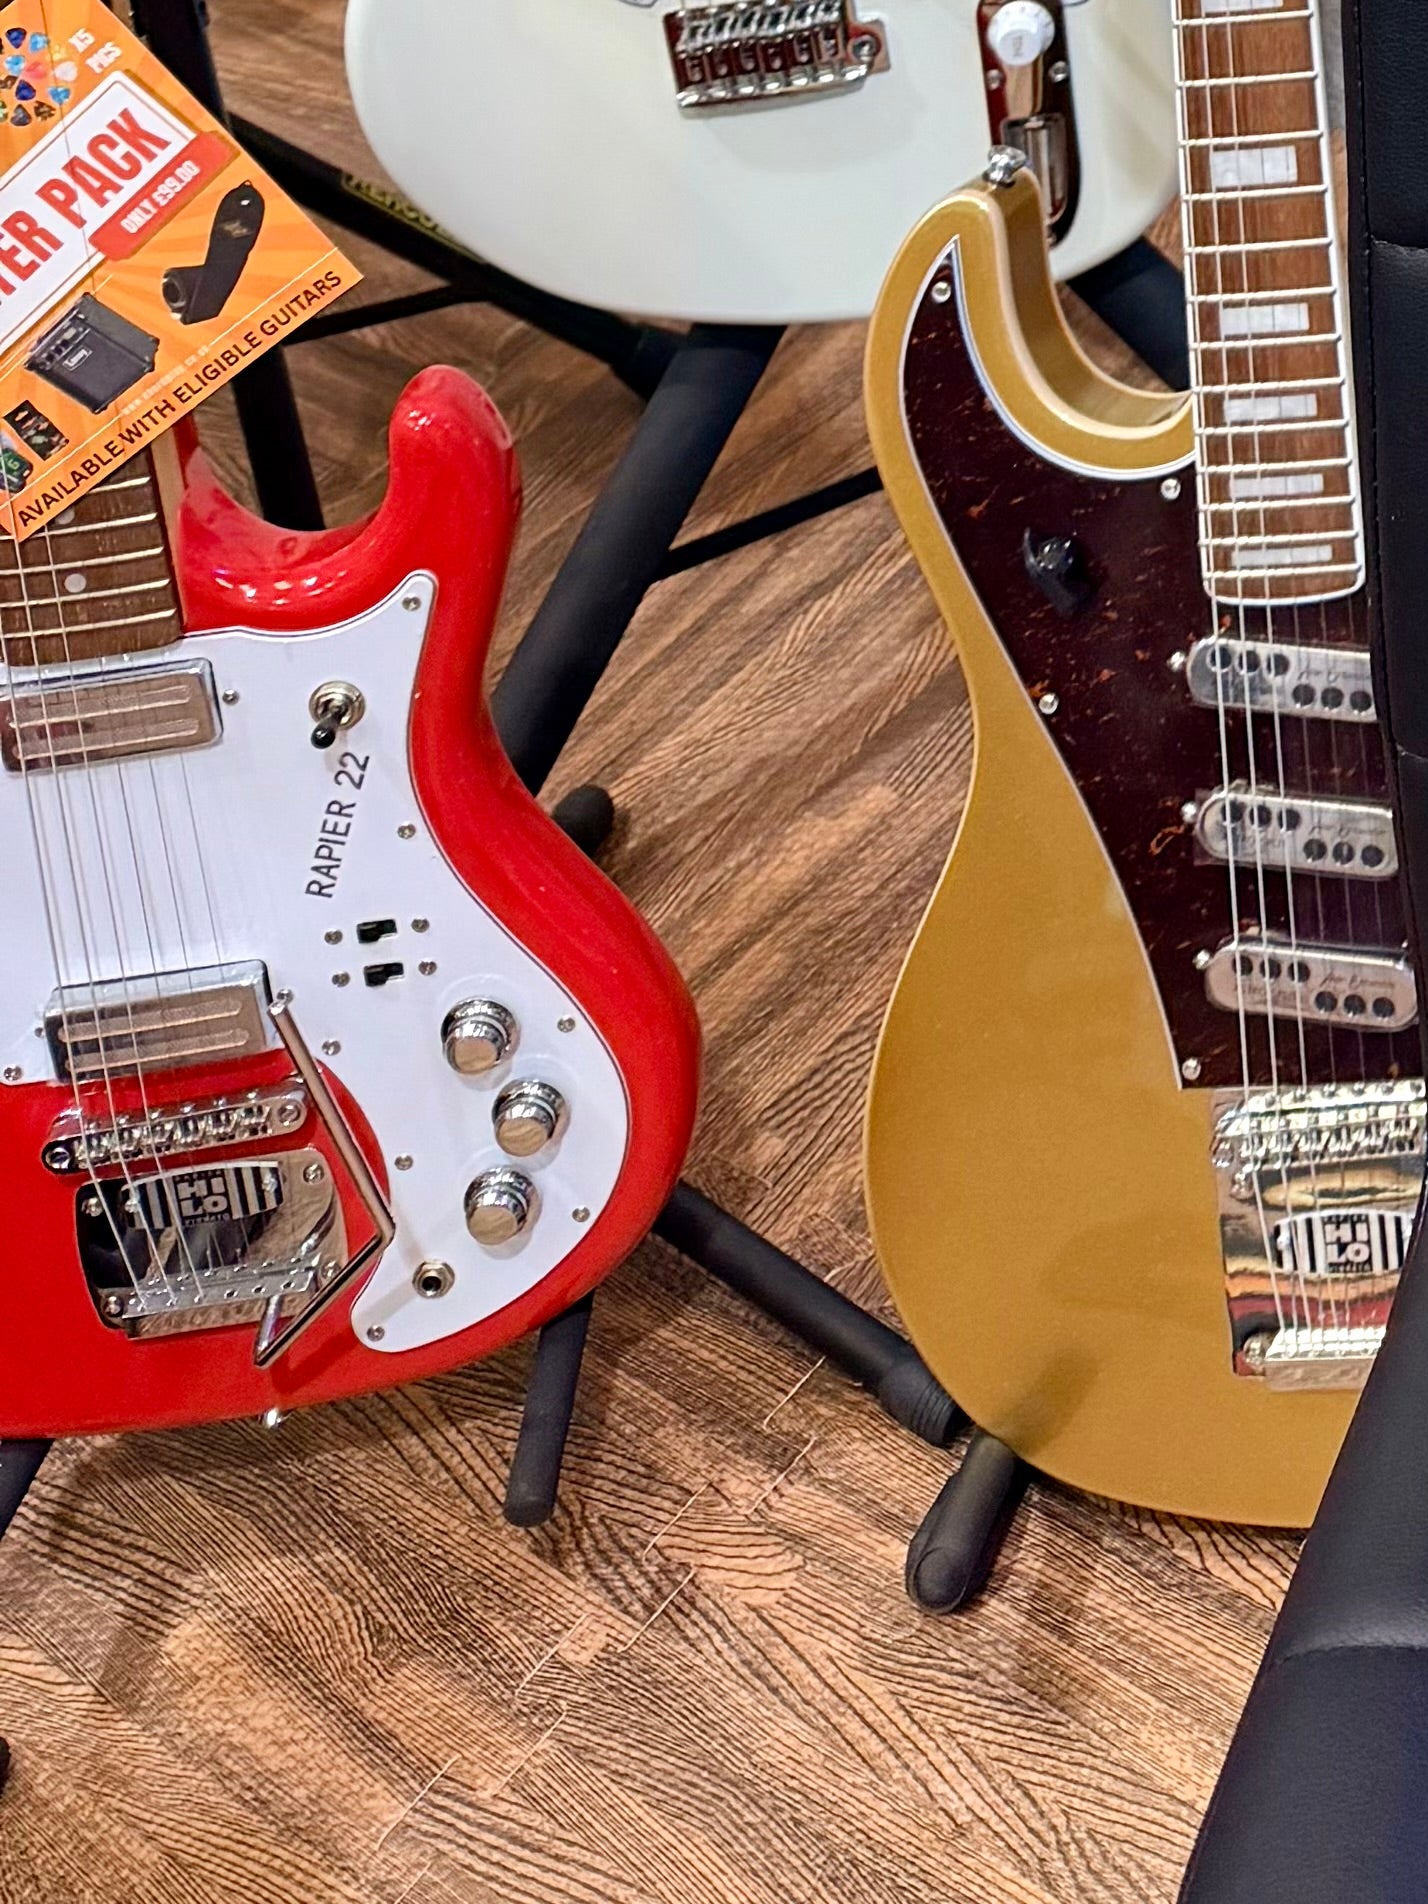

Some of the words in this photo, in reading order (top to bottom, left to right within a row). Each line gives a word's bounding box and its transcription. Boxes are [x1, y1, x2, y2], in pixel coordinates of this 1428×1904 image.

[35, 108, 172, 229] PACK
[120, 199, 158, 233] ONLY
[18, 440, 124, 527] AVAILABLE
[120, 400, 176, 443] WITH
[172, 331, 262, 404] ELIGIBLE
[261, 270, 342, 336] GUITARS
[305, 800, 356, 898] RAPIER
[334, 752, 370, 790] 22
